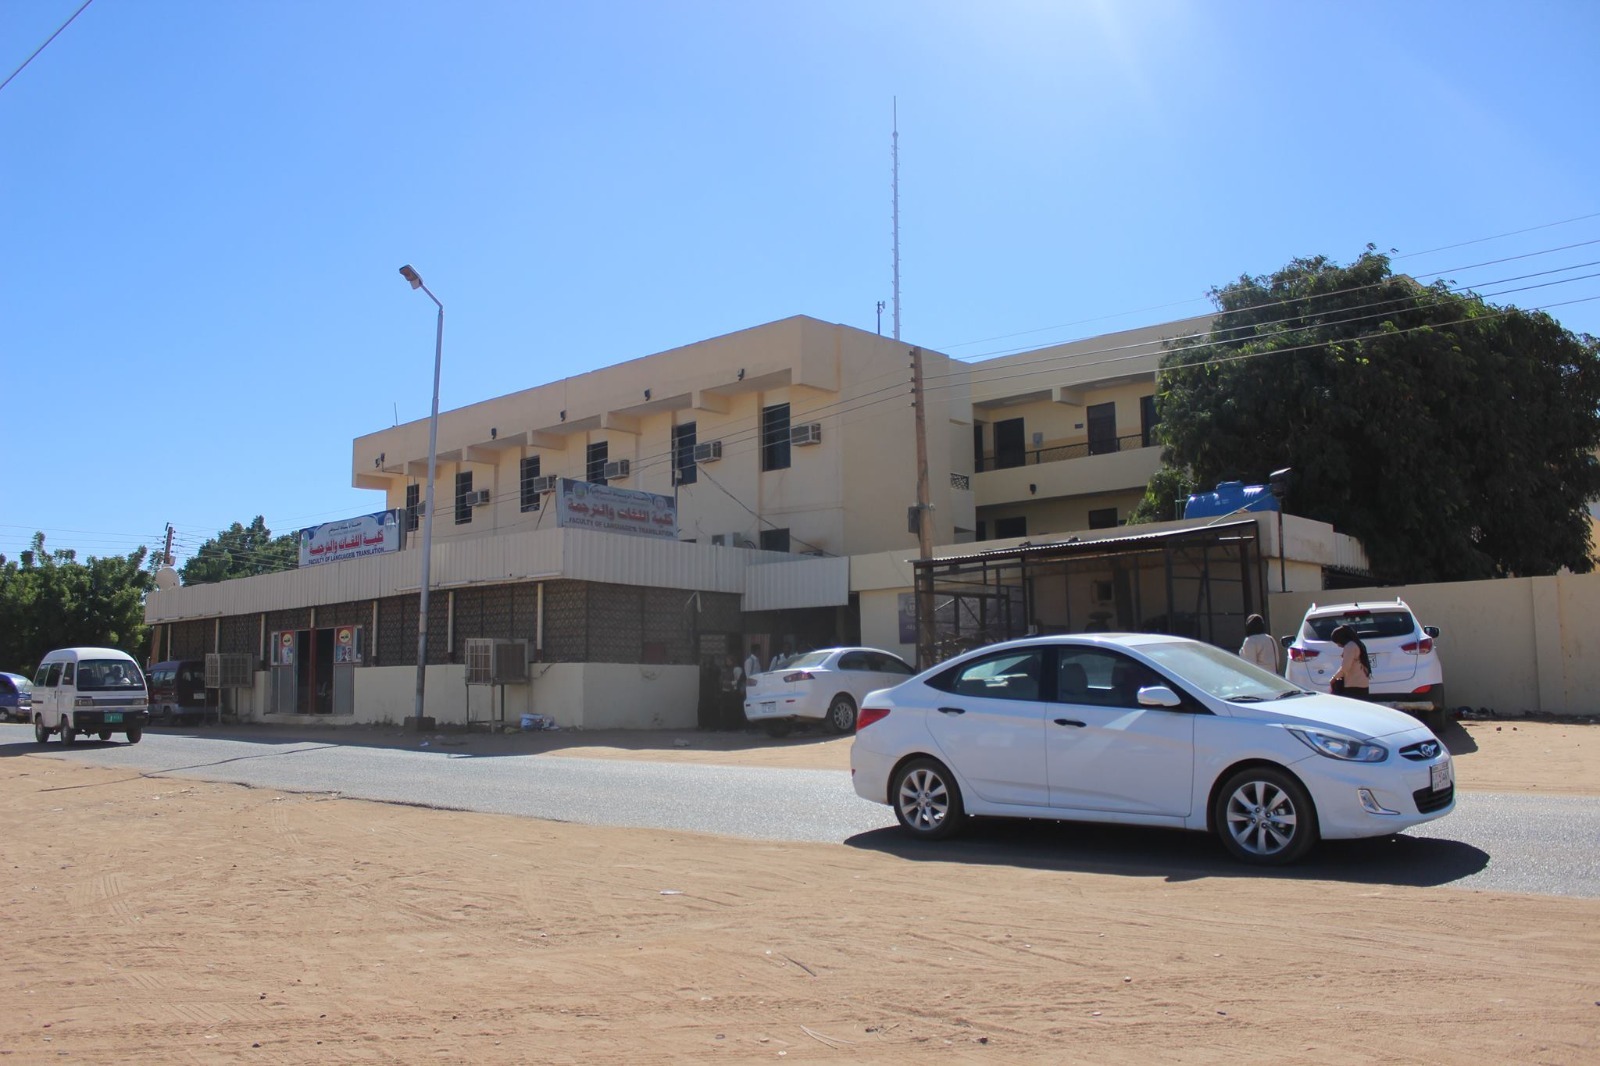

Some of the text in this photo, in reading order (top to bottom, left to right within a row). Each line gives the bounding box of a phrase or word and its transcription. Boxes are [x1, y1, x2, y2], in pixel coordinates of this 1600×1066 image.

[569, 517, 594, 526] FACULTY
[595, 519, 603, 527] OF
[639, 527, 674, 536] TRANSLATION
[308, 555, 325, 565] FACULTY
[356, 547, 385, 557] TRANSLATION
